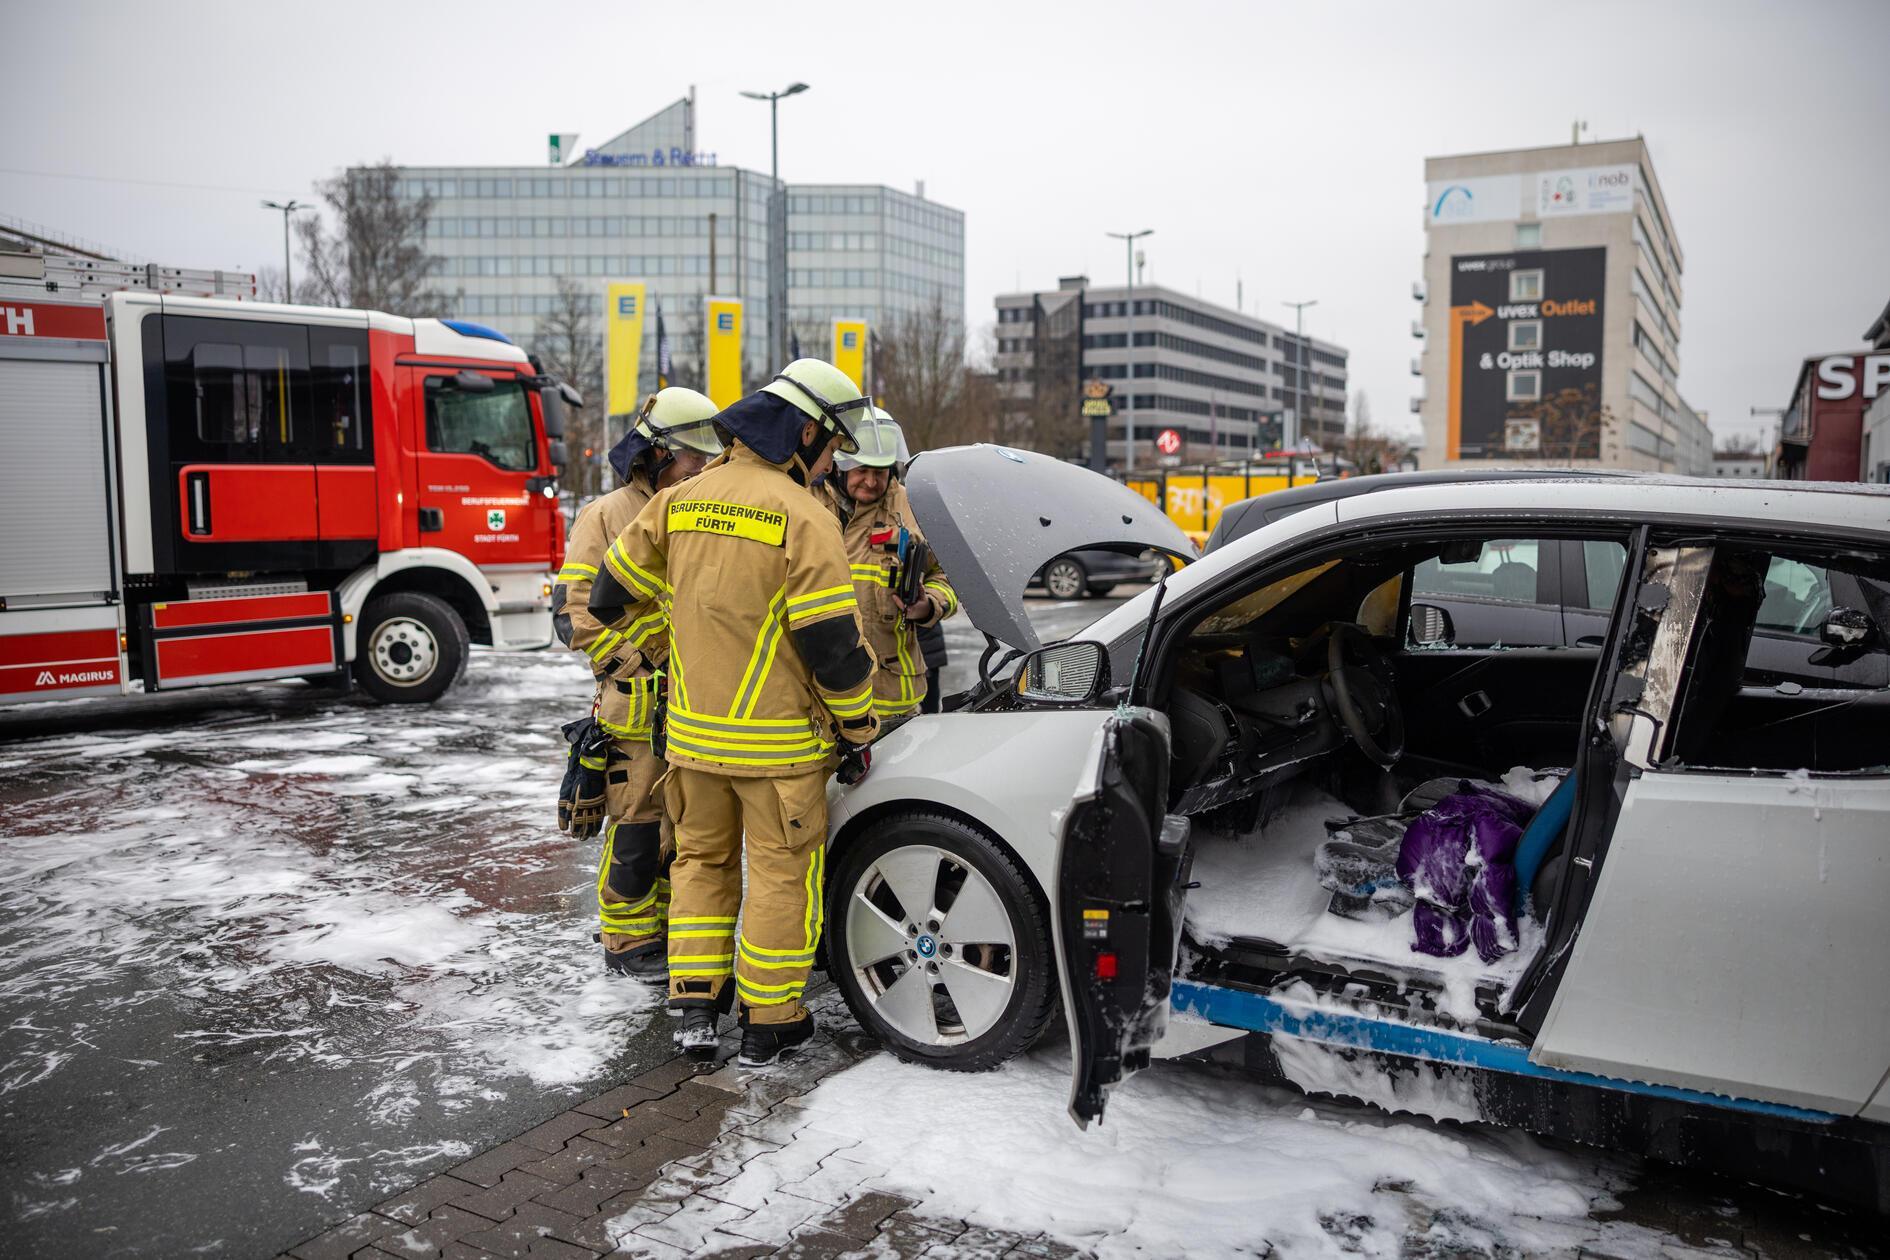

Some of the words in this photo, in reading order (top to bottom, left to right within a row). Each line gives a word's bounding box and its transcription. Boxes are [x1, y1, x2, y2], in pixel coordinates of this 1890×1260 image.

[618, 296, 636, 314] E
[1497, 304, 1538, 318] uvex
[1541, 300, 1596, 317] Outlet
[0, 307, 35, 336] H
[718, 314, 733, 330] E
[843, 332, 857, 347] E
[1480, 353, 1494, 369] &
[1497, 352, 1544, 370] Optik
[1548, 351, 1595, 370] Shop
[671, 502, 783, 527] BERUFSFEUERWEHR
[695, 515, 736, 532] FÜRTH
[59, 670, 114, 684] MAGIRUS
